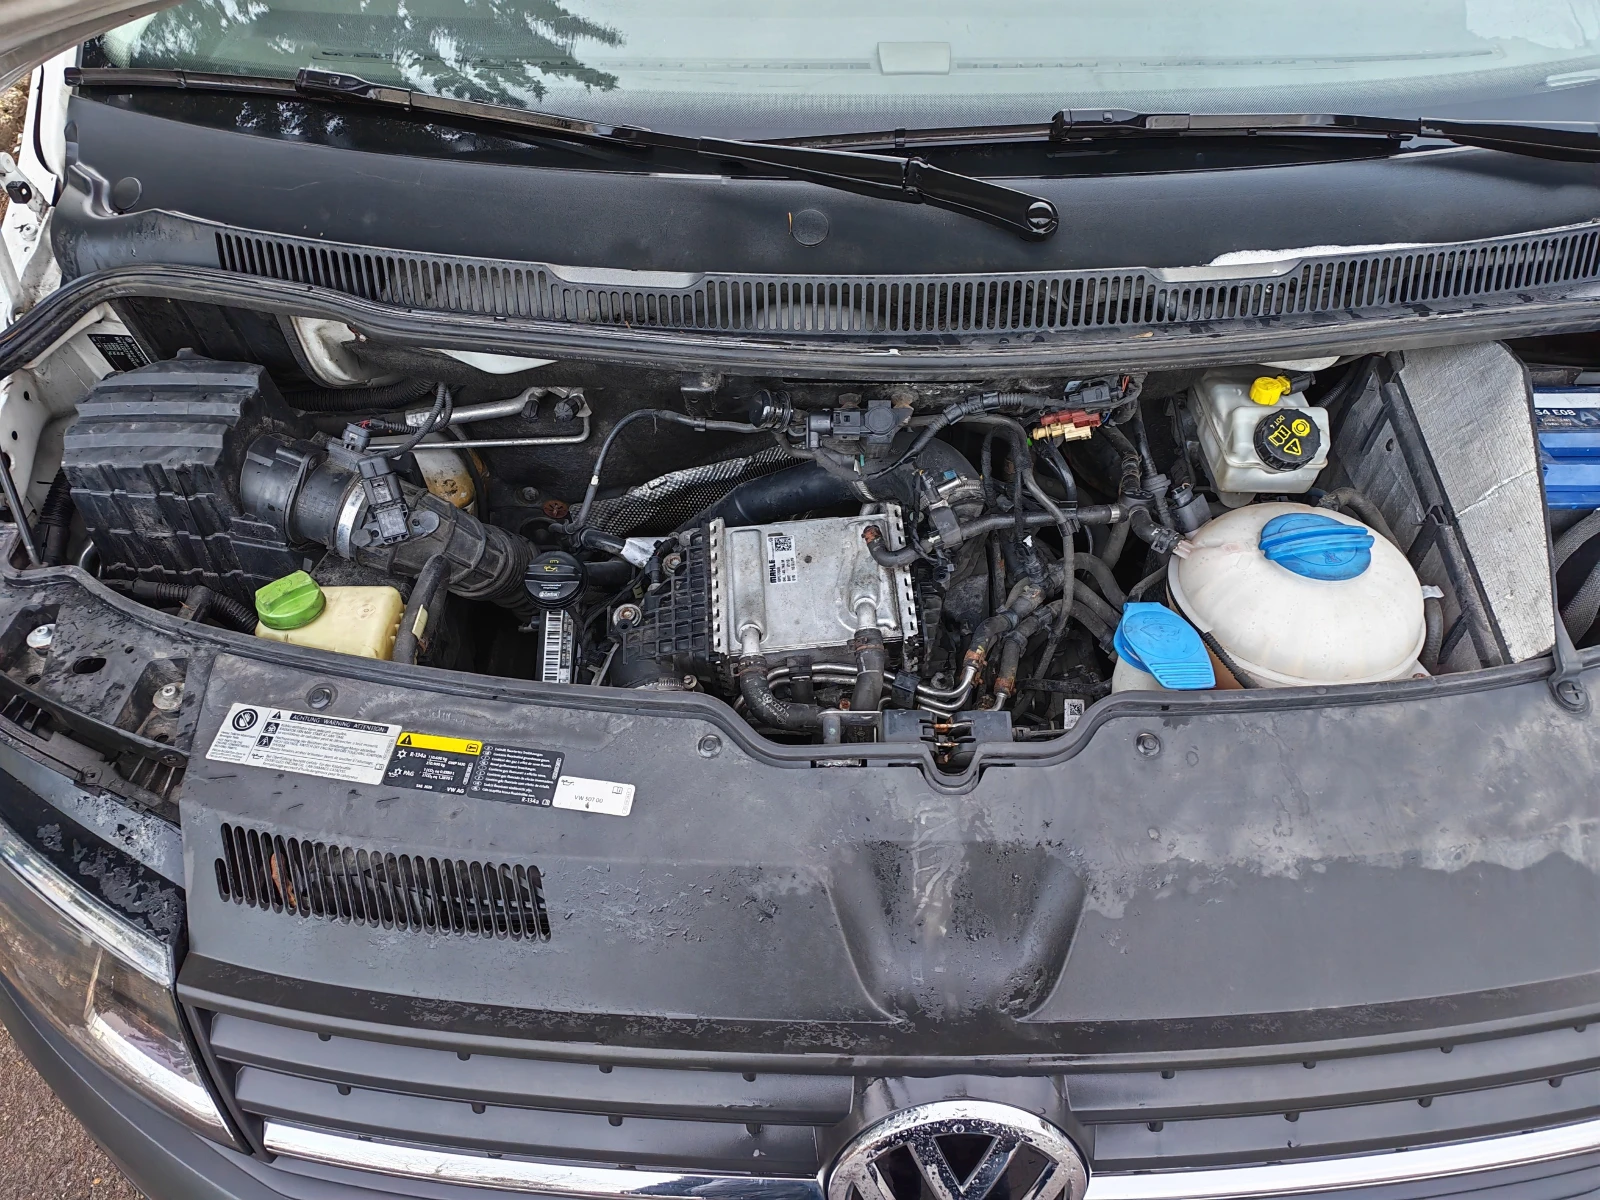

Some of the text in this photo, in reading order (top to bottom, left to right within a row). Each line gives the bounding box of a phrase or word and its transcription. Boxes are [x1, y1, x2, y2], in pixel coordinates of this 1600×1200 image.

[1274, 415, 1286, 425] DOT
[769, 560, 777, 583] MAHLE
[292, 714, 321, 724] ACHTUNG
[323, 719, 351, 728] WARNING
[353, 723, 384, 733] ATTENTION
[409, 751, 427, 759] R-134a
